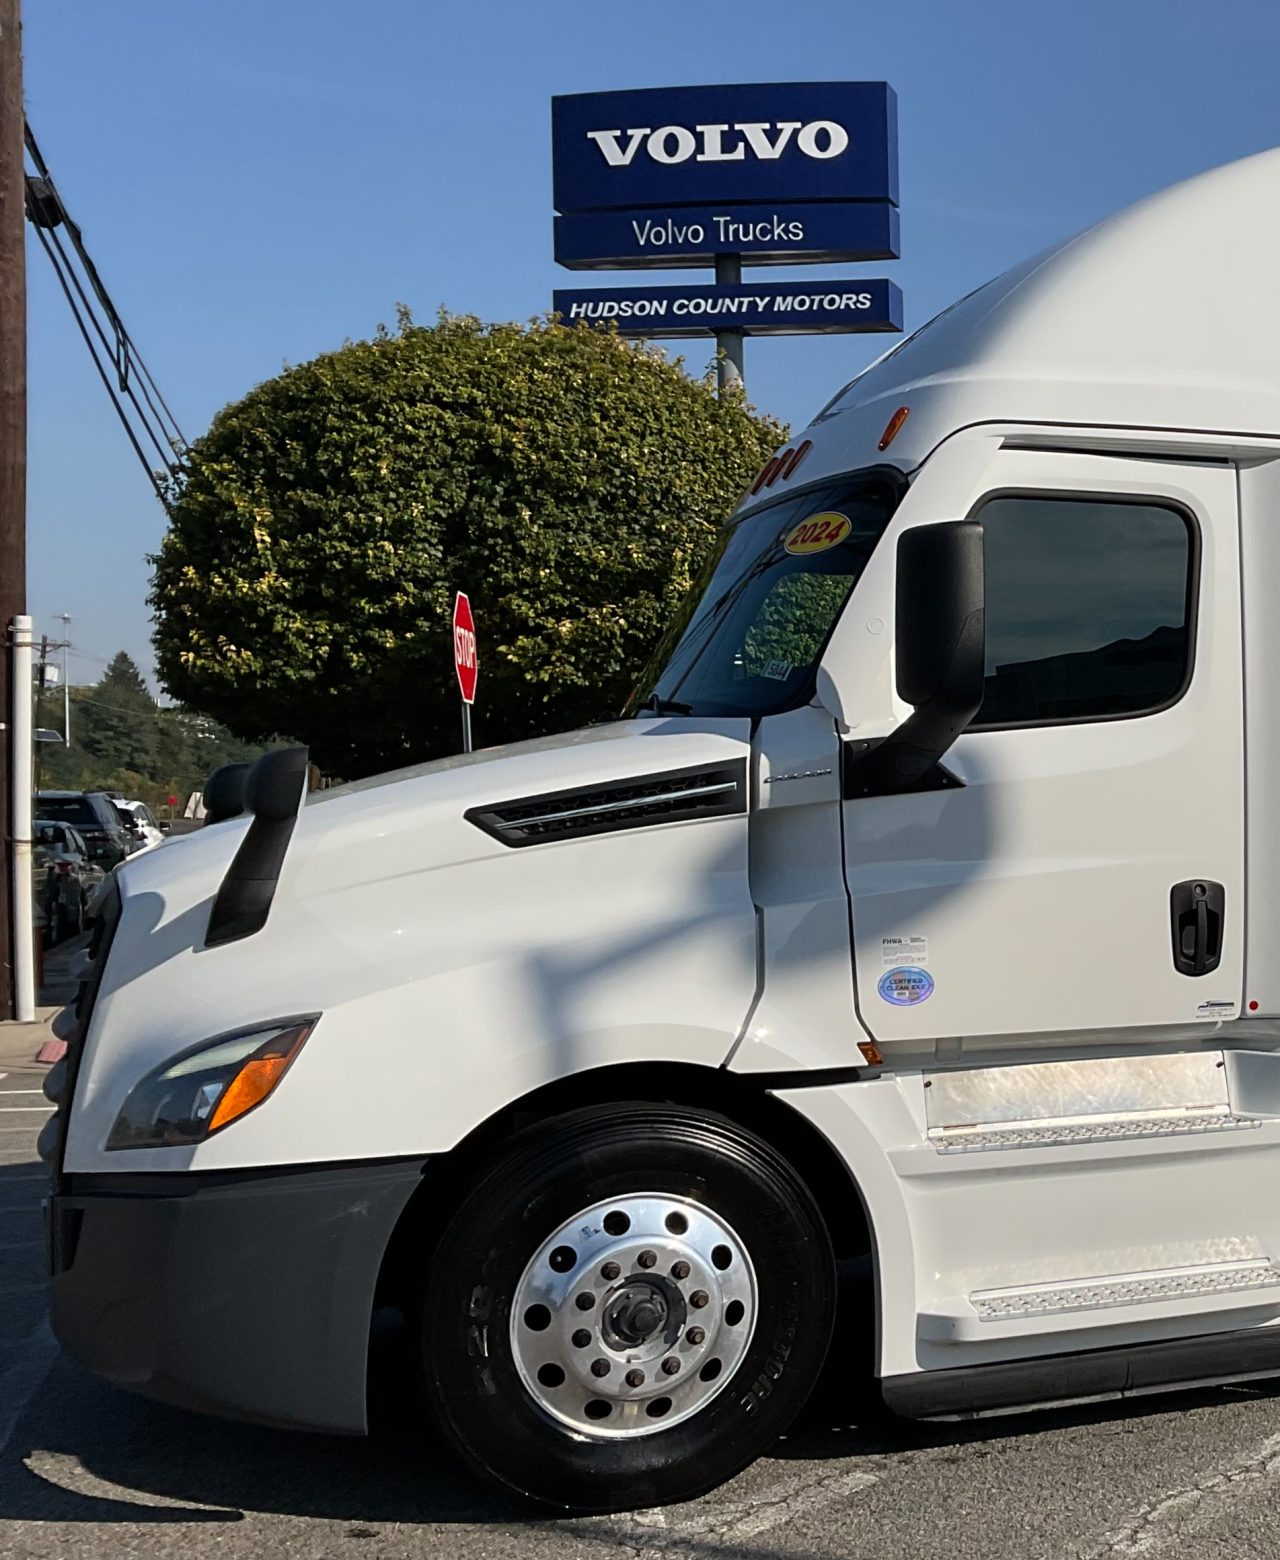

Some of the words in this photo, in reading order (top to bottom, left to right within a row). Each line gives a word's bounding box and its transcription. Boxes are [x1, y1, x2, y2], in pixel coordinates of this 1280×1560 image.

[587, 120, 849, 166] VOLVO
[632, 218, 705, 246] Volvo
[712, 214, 804, 242] Trucks
[569, 299, 668, 319] HUDSON
[672, 296, 770, 316] COUNTY
[773, 293, 872, 312] MOTORS
[788, 520, 846, 547] 2024
[456, 626, 475, 669] STOP
